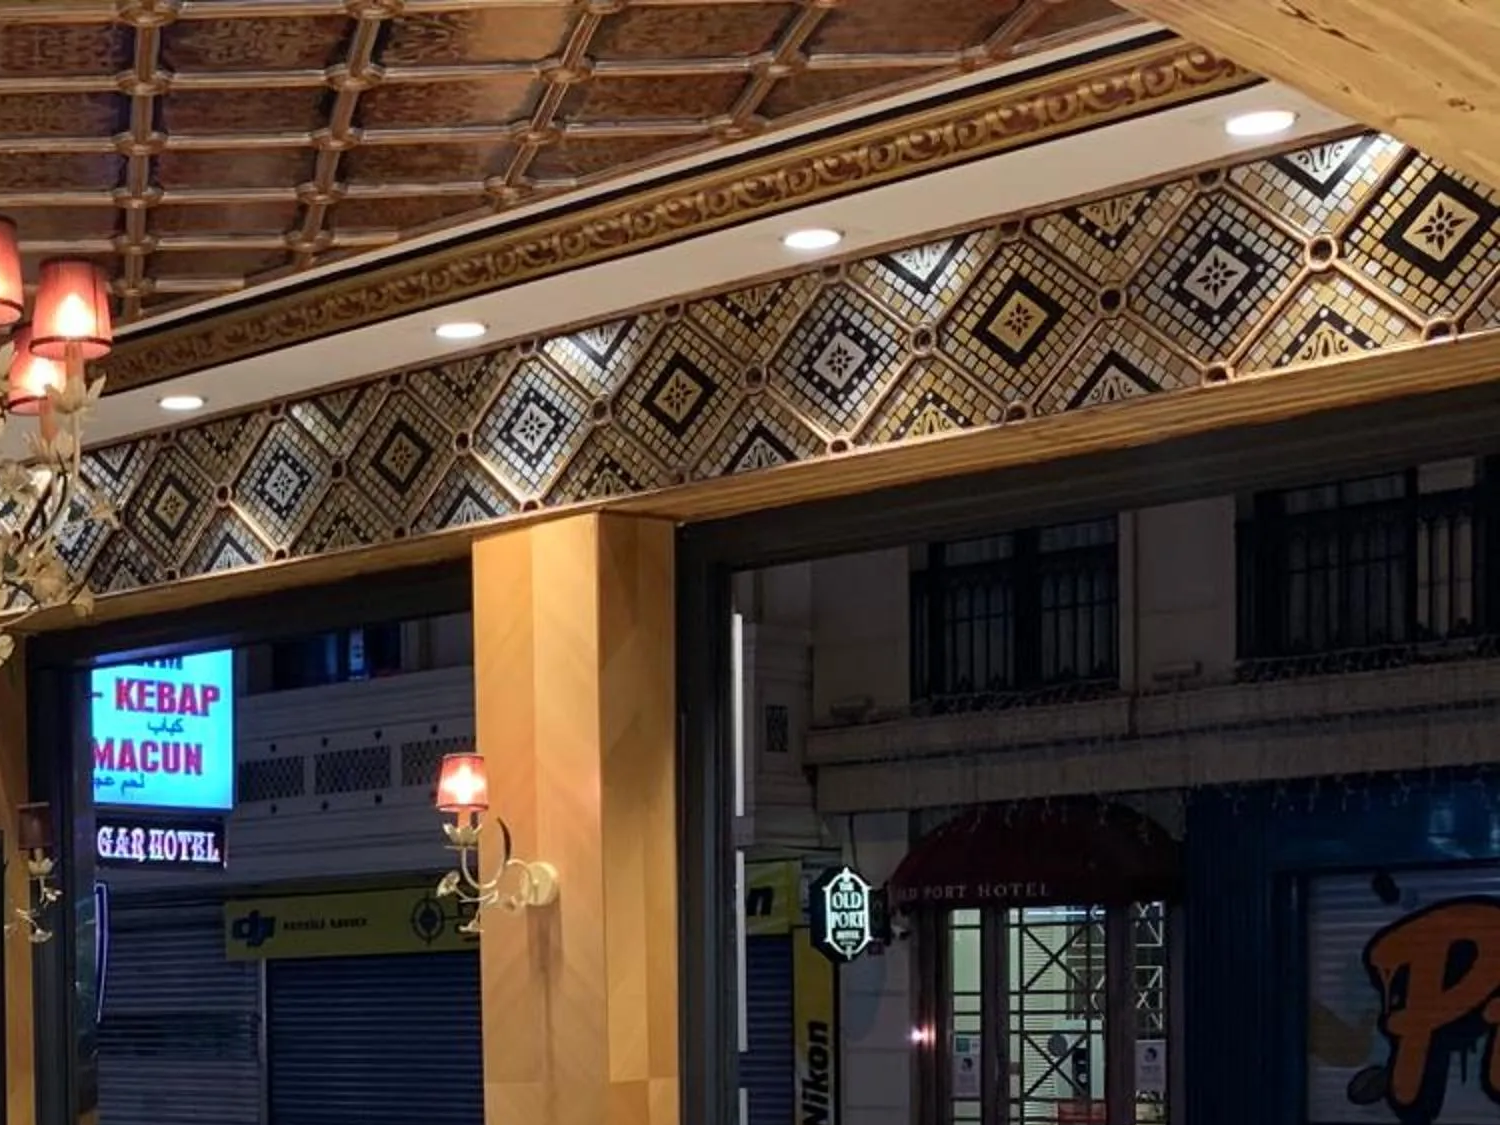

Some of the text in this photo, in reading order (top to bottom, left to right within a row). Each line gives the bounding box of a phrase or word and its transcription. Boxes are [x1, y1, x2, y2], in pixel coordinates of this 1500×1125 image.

[115, 677, 220, 717] KEBAP
[148, 829, 221, 863] HOTEL
[978, 881, 1050, 897] HOTEL
[832, 891, 863, 909] OLD
[830, 911, 864, 929] PORT
